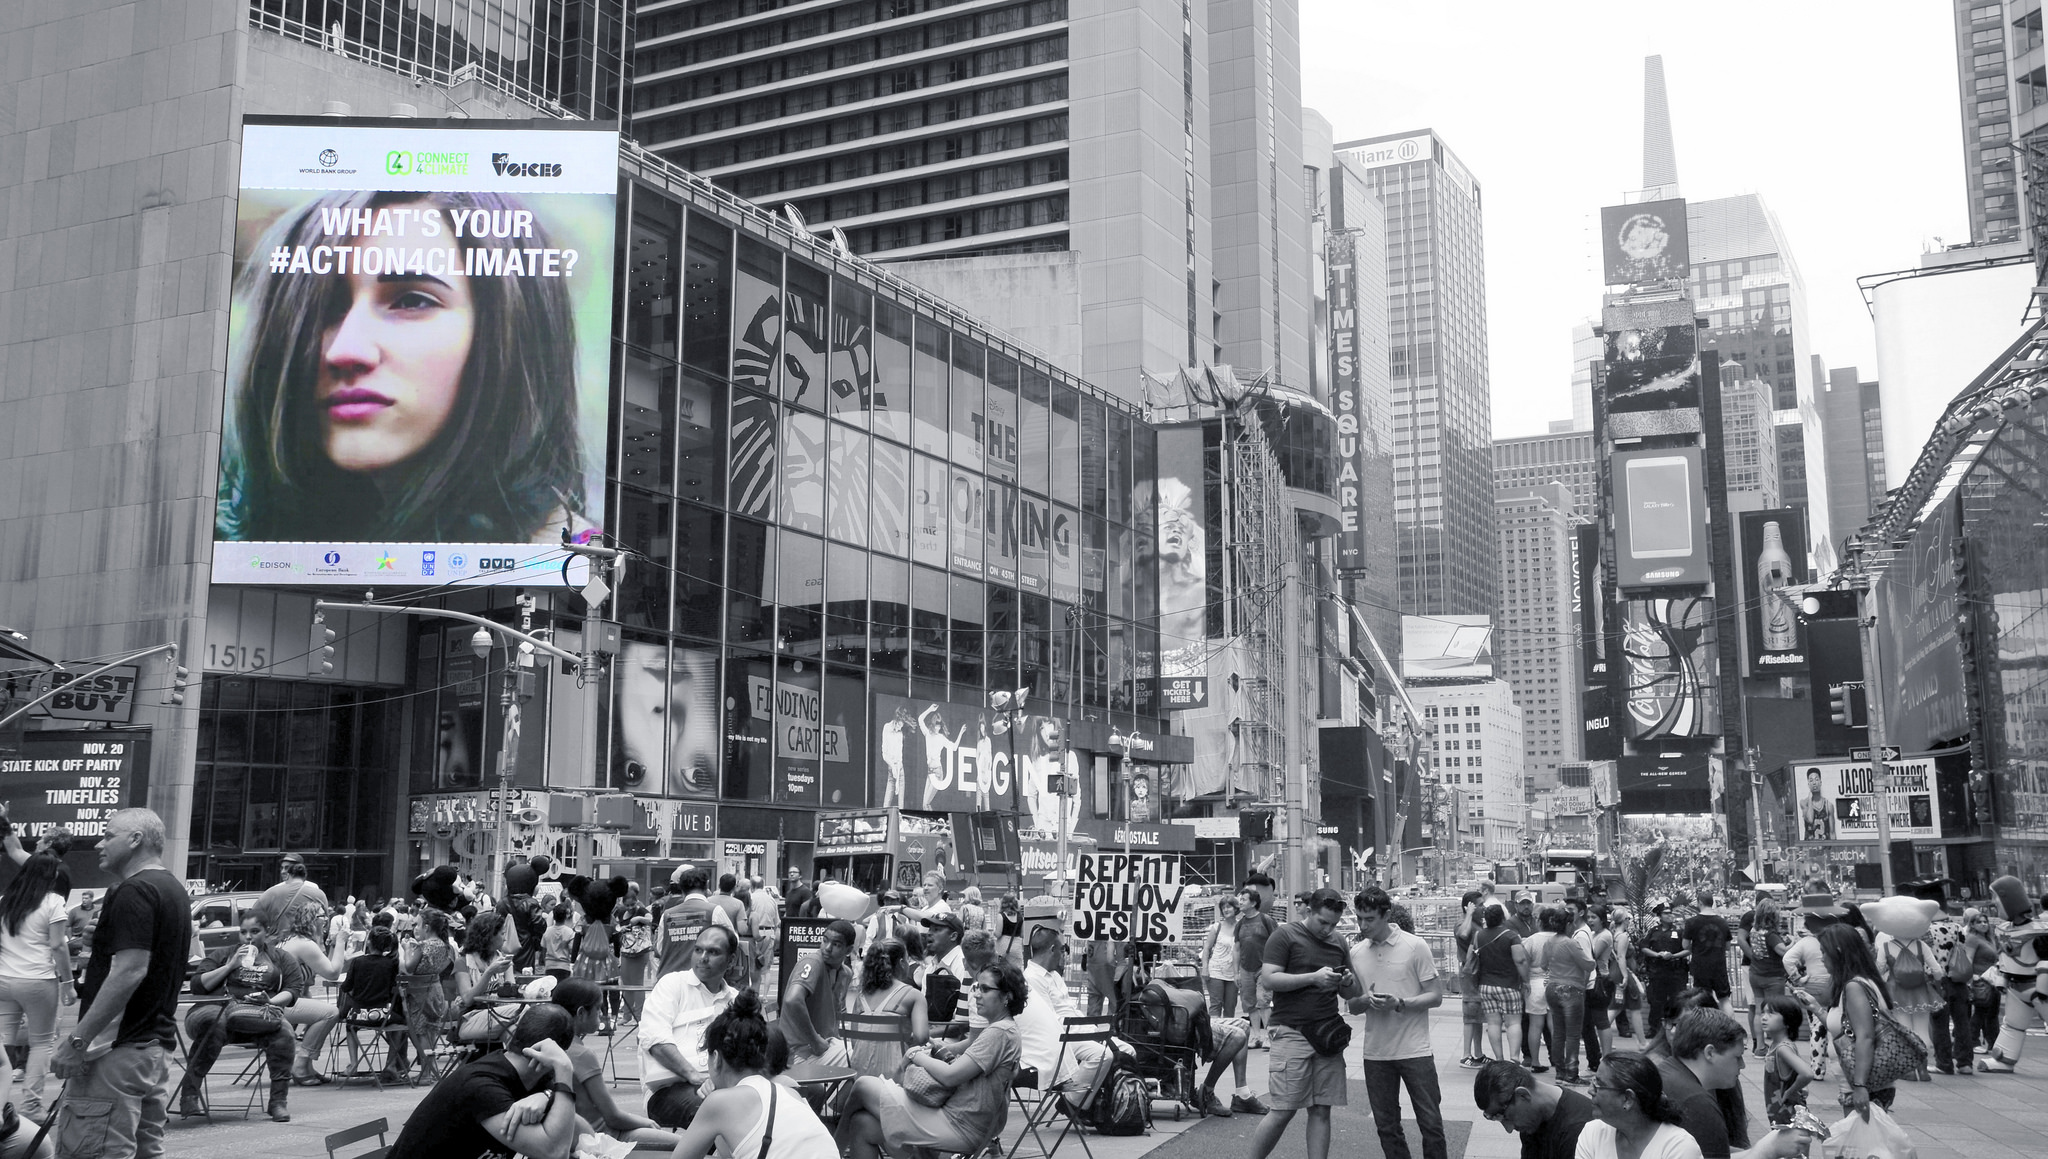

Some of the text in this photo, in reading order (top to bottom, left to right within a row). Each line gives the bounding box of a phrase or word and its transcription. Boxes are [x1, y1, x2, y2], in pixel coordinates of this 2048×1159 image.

[417, 152, 469, 164] CONNECT
[416, 163, 469, 175] 4CLIMATE
[321, 208, 533, 238] WHAT'S YOUR
[269, 245, 579, 277] #ACTION4CLIMATE?
[1332, 264, 1359, 532] TIMES SQUARE
[971, 412, 1017, 464] THE
[1002, 474, 1070, 560] KING
[953, 556, 1037, 587] ENTRANCE ON 45TH STREET
[210, 644, 265, 669] 1515
[1759, 654, 1803, 664] #RiseAsOne
[52, 672, 133, 693] BEST
[1172, 681, 1191, 689] GET
[52, 692, 124, 712] BUY
[757, 685, 818, 722] FINDING
[788, 725, 839, 755] CARTER
[83, 743, 124, 755] NOV. 20
[2, 759, 122, 772] STATE KICK OFF PARTY
[80, 777, 120, 788] NOV. 22
[787, 773, 814, 784] tuesdays
[1838, 767, 1874, 795] JACOB
[1903, 777, 1912, 785] 44
[788, 784, 804, 793] 10pm
[45, 789, 119, 804] TIMEFLIES
[77, 808, 102, 820] NOV.
[735, 844, 765, 855] BILLABONG
[1074, 882, 1184, 914] FOLLOW
[668, 927, 686, 936] TICKET
[789, 927, 806, 935] FREE
[808, 927, 814, 935] &
[1073, 911, 1176, 942] JESUS.
[801, 964, 811, 978] 3
